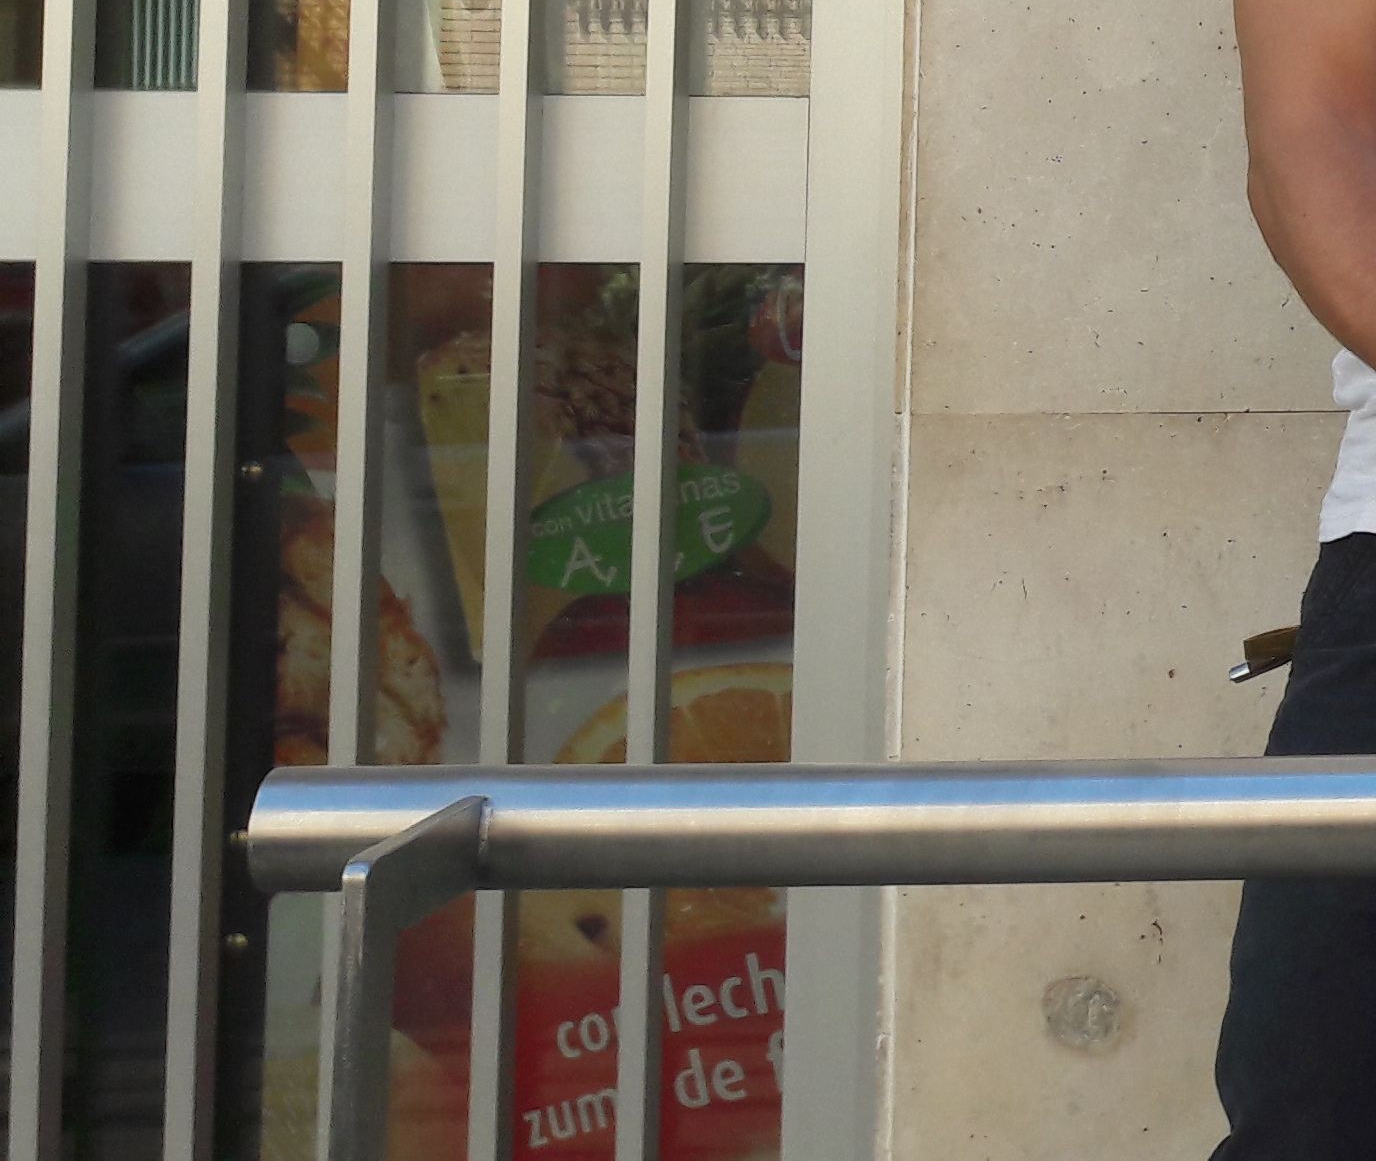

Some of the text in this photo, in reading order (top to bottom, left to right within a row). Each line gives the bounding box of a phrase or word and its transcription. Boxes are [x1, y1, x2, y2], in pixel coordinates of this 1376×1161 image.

[697, 506, 735, 554] E
[662, 952, 786, 1033] lech
[522, 1087, 619, 1149] zum
[673, 1047, 748, 1109] de
